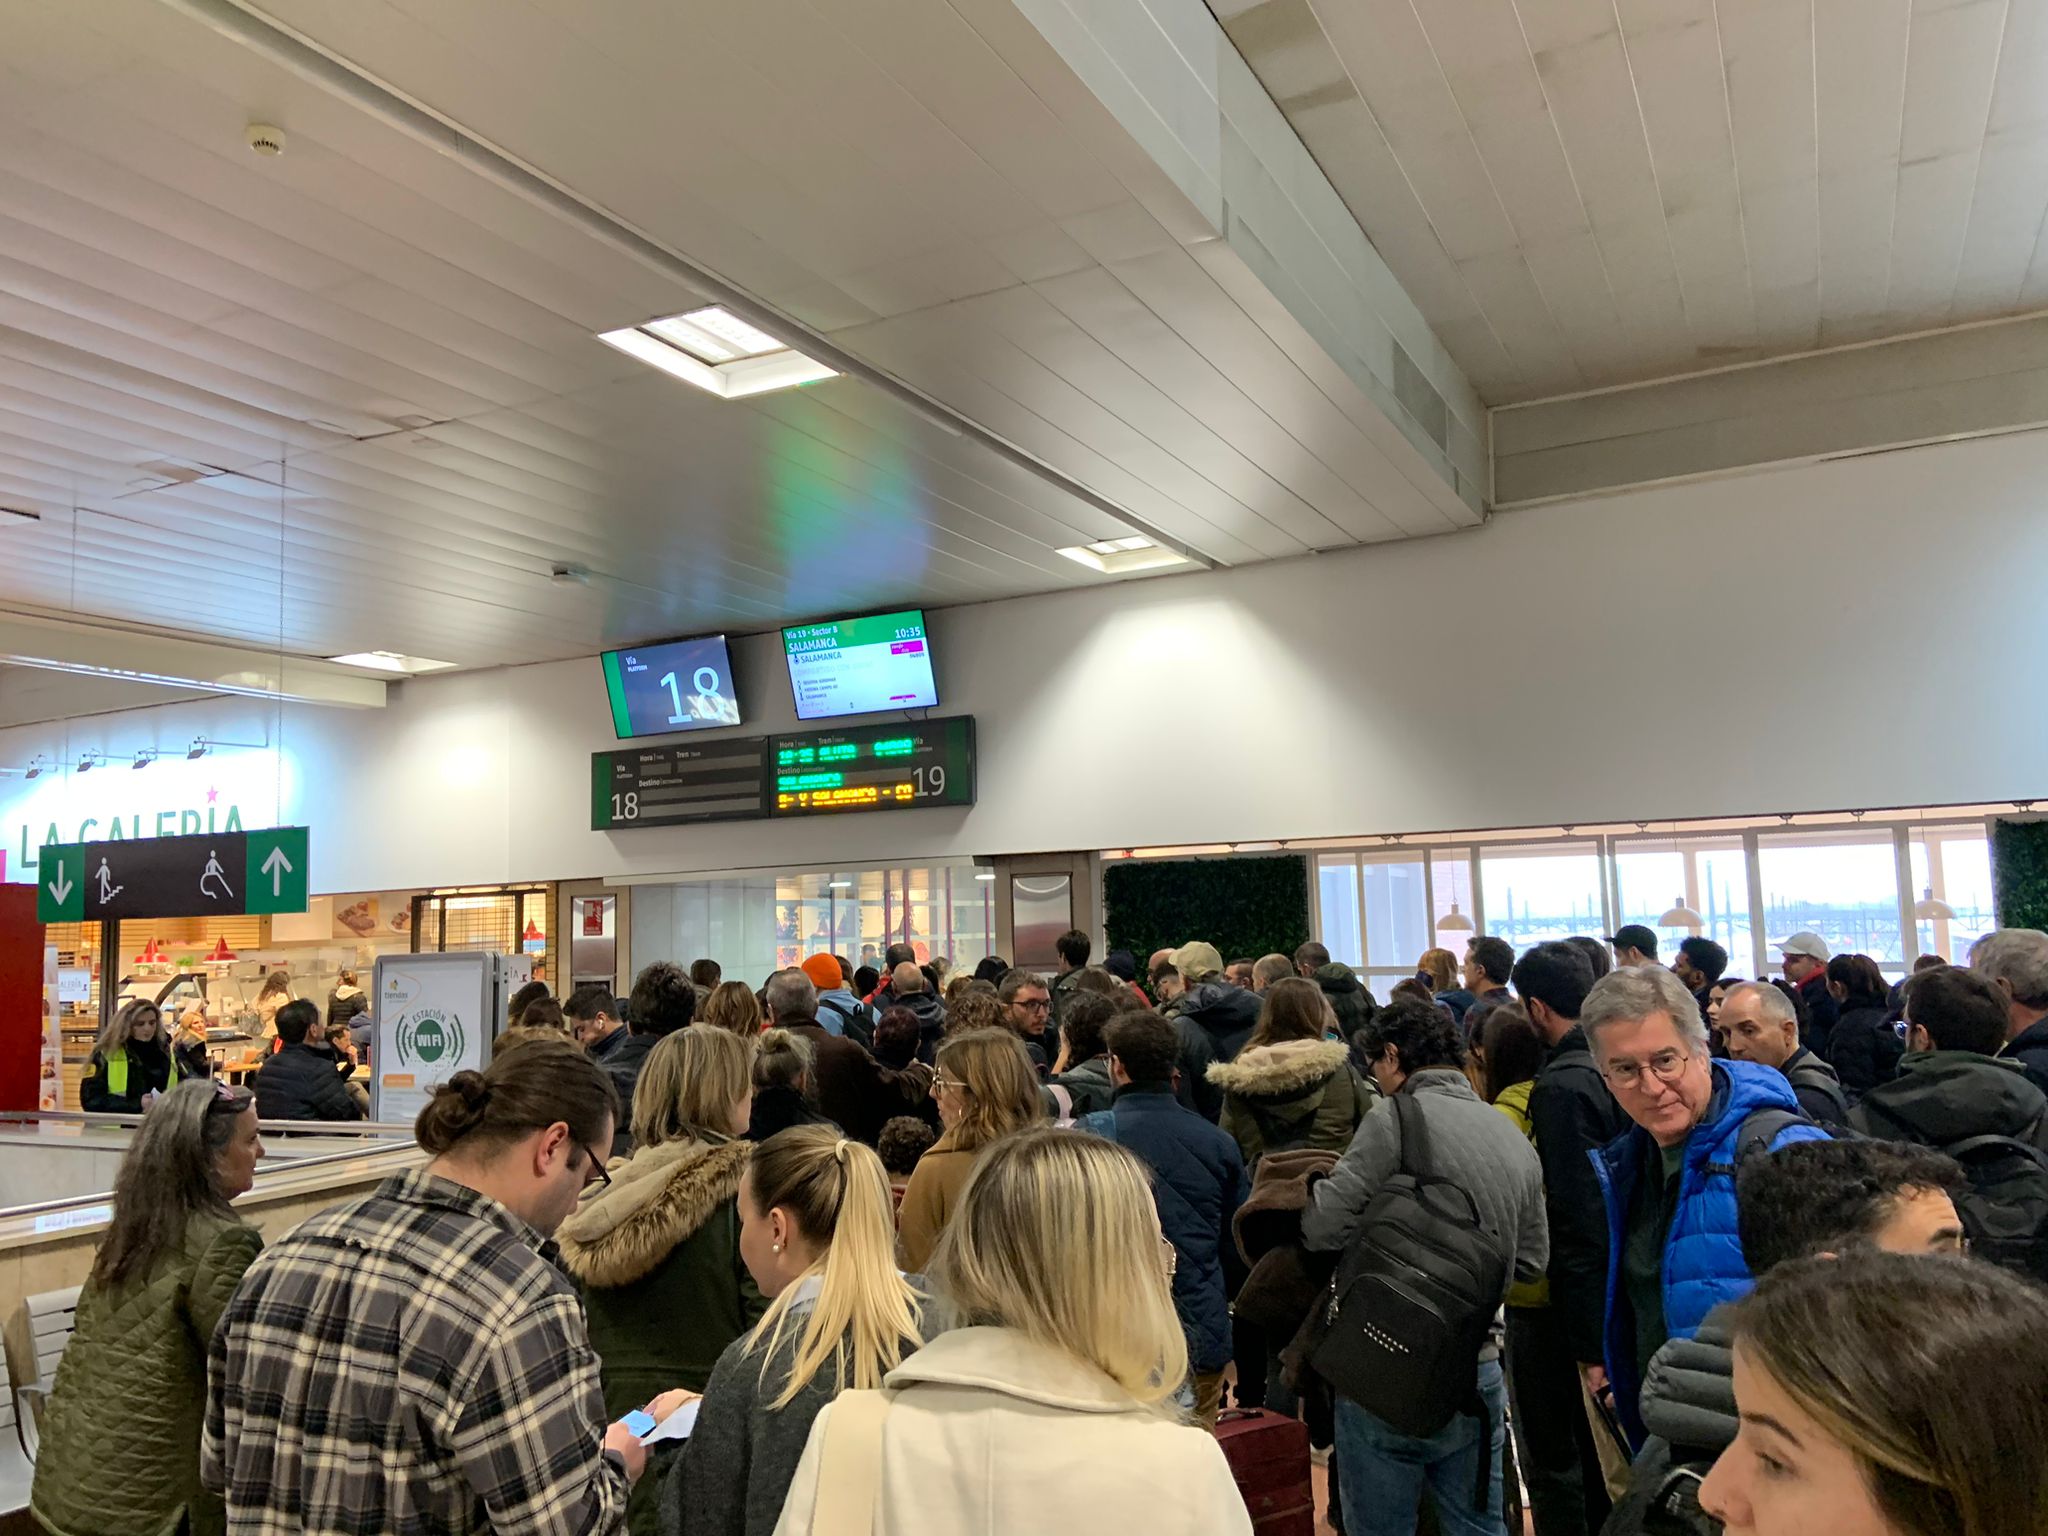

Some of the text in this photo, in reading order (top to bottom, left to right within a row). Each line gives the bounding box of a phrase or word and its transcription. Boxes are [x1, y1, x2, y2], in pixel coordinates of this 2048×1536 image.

[798, 630, 807, 638] 19
[811, 627, 832, 636] Sector
[895, 626, 921, 639] 10:35
[789, 637, 838, 653] SALAMANCA
[626, 656, 637, 665] Vía
[801, 651, 842, 664] SALAMANCA
[660, 667, 725, 725] 18
[779, 741, 794, 749] Hora
[818, 737, 832, 745] Tren
[676, 751, 689, 759] Tren
[777, 766, 800, 775] Destino
[639, 778, 661, 787] Destino
[912, 765, 946, 797] 19
[611, 792, 639, 820] 18
[384, 991, 408, 999] tiendas
[412, 1009, 447, 1024] ESTACIÓN
